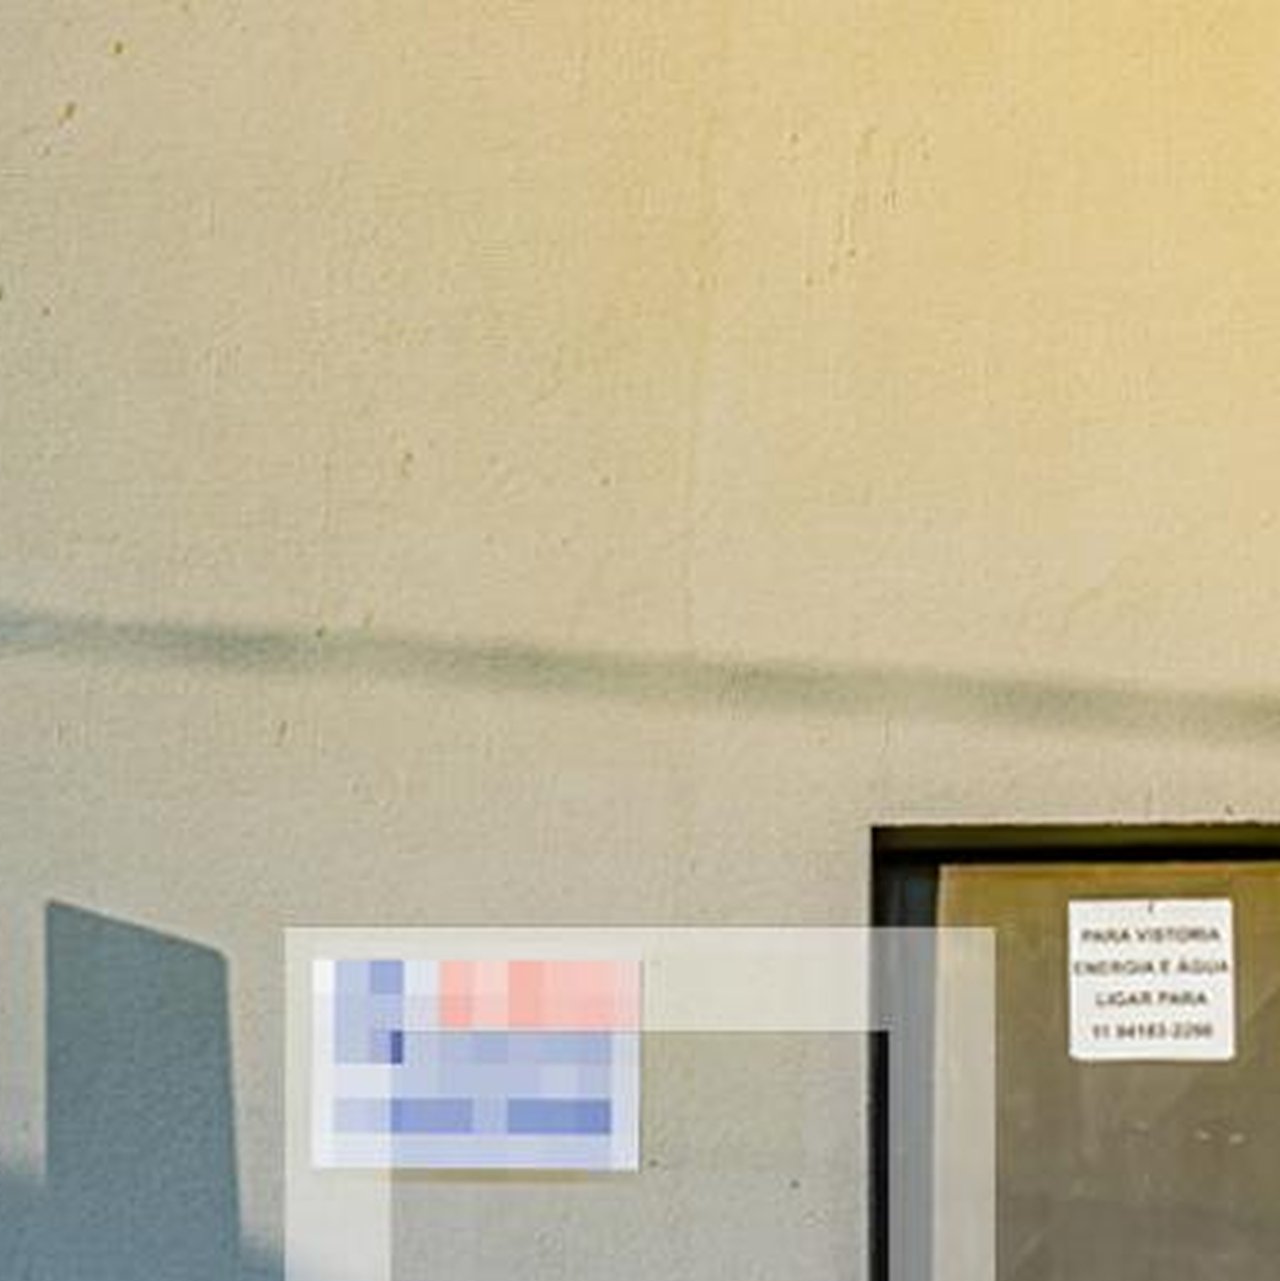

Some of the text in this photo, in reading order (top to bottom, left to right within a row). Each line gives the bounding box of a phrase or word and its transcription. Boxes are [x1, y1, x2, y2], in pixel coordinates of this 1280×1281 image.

[1080, 926, 1220, 944] PARA VISTORIA
[1073, 959, 1153, 976] ENERGIA
[1160, 960, 1171, 974] E
[1095, 991, 1207, 1006] LIGAR PARA
